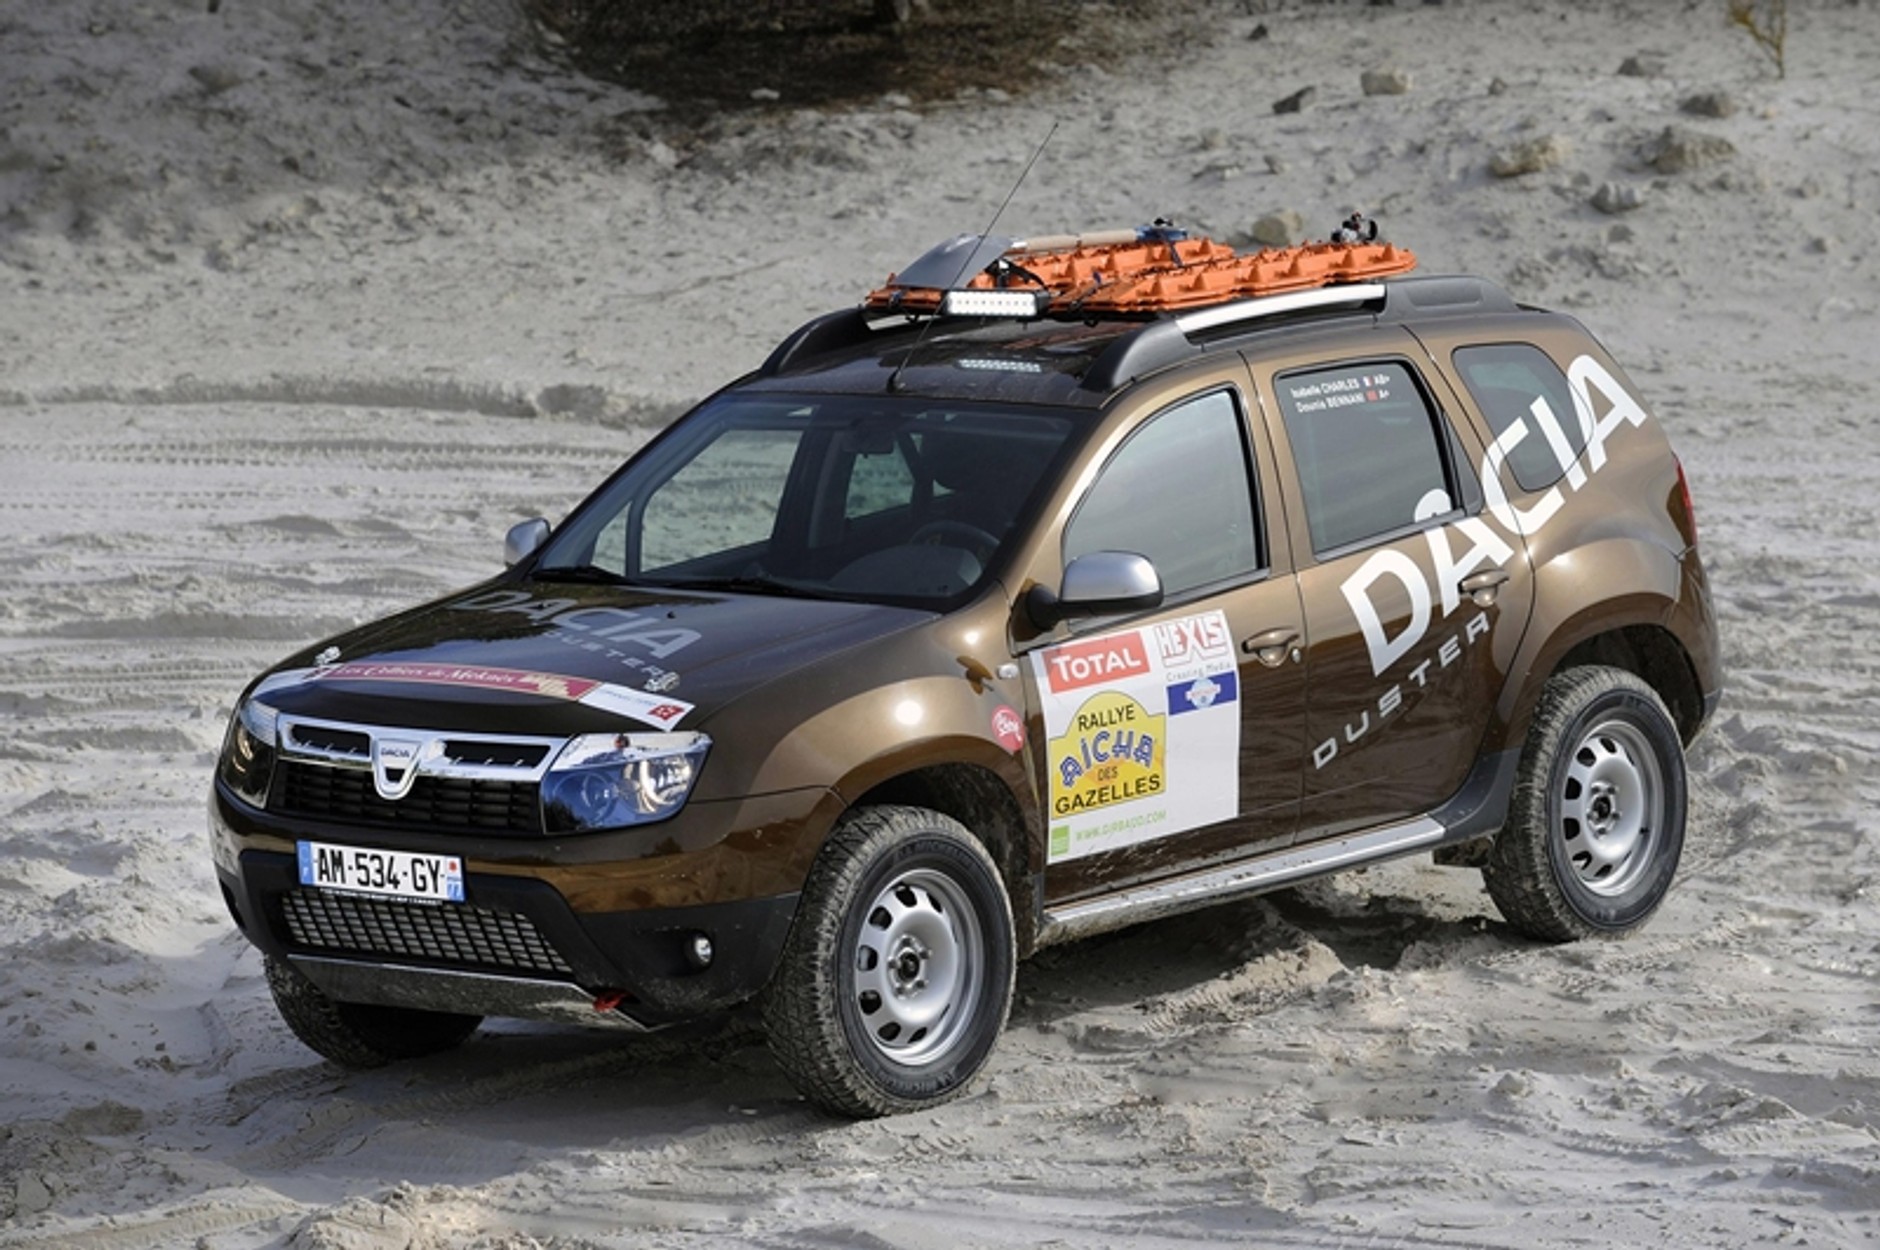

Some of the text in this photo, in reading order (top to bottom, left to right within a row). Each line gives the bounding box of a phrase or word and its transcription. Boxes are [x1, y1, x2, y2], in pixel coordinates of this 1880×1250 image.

[1321, 377, 1360, 393] CHARLES
[1340, 354, 1647, 677] DACIA
[449, 590, 702, 659] DACIA
[1154, 613, 1229, 667] HEXIS
[1313, 611, 1489, 769] DUSTER
[1077, 703, 1136, 732] RALLYE
[1055, 773, 1161, 815] GAZELLES
[1097, 766, 1118, 781] DES
